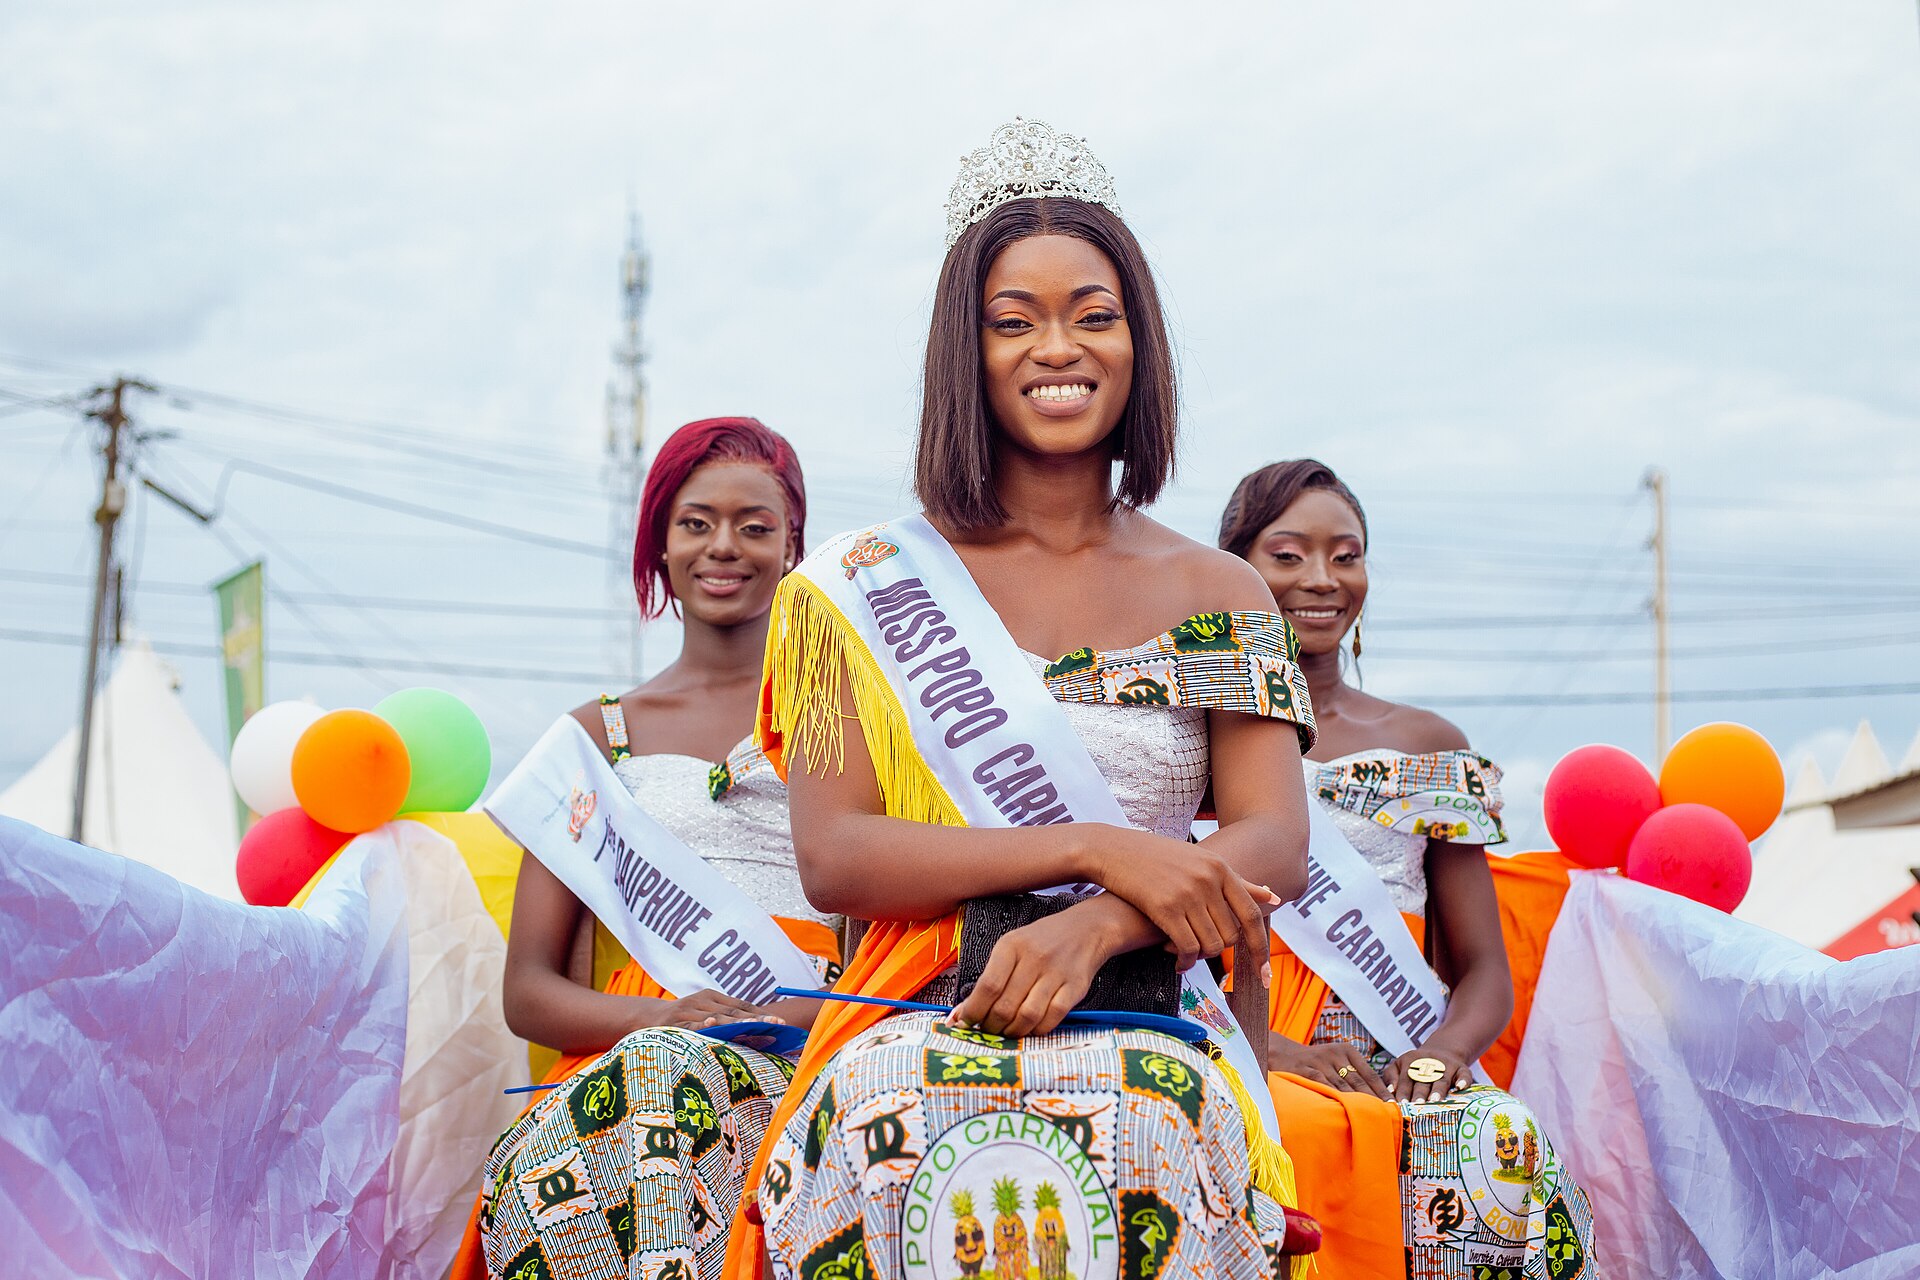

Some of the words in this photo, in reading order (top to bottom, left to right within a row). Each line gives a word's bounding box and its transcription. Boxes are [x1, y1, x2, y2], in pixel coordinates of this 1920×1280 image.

[865, 577, 957, 664] MISS
[907, 646, 1009, 750] POPO
[613, 836, 712, 950] DAUPHINE
[1326, 908, 1439, 1048] CARNAVAL
[906, 1143, 956, 1266] POPO
[964, 1114, 1114, 1258] CARNAVAL
